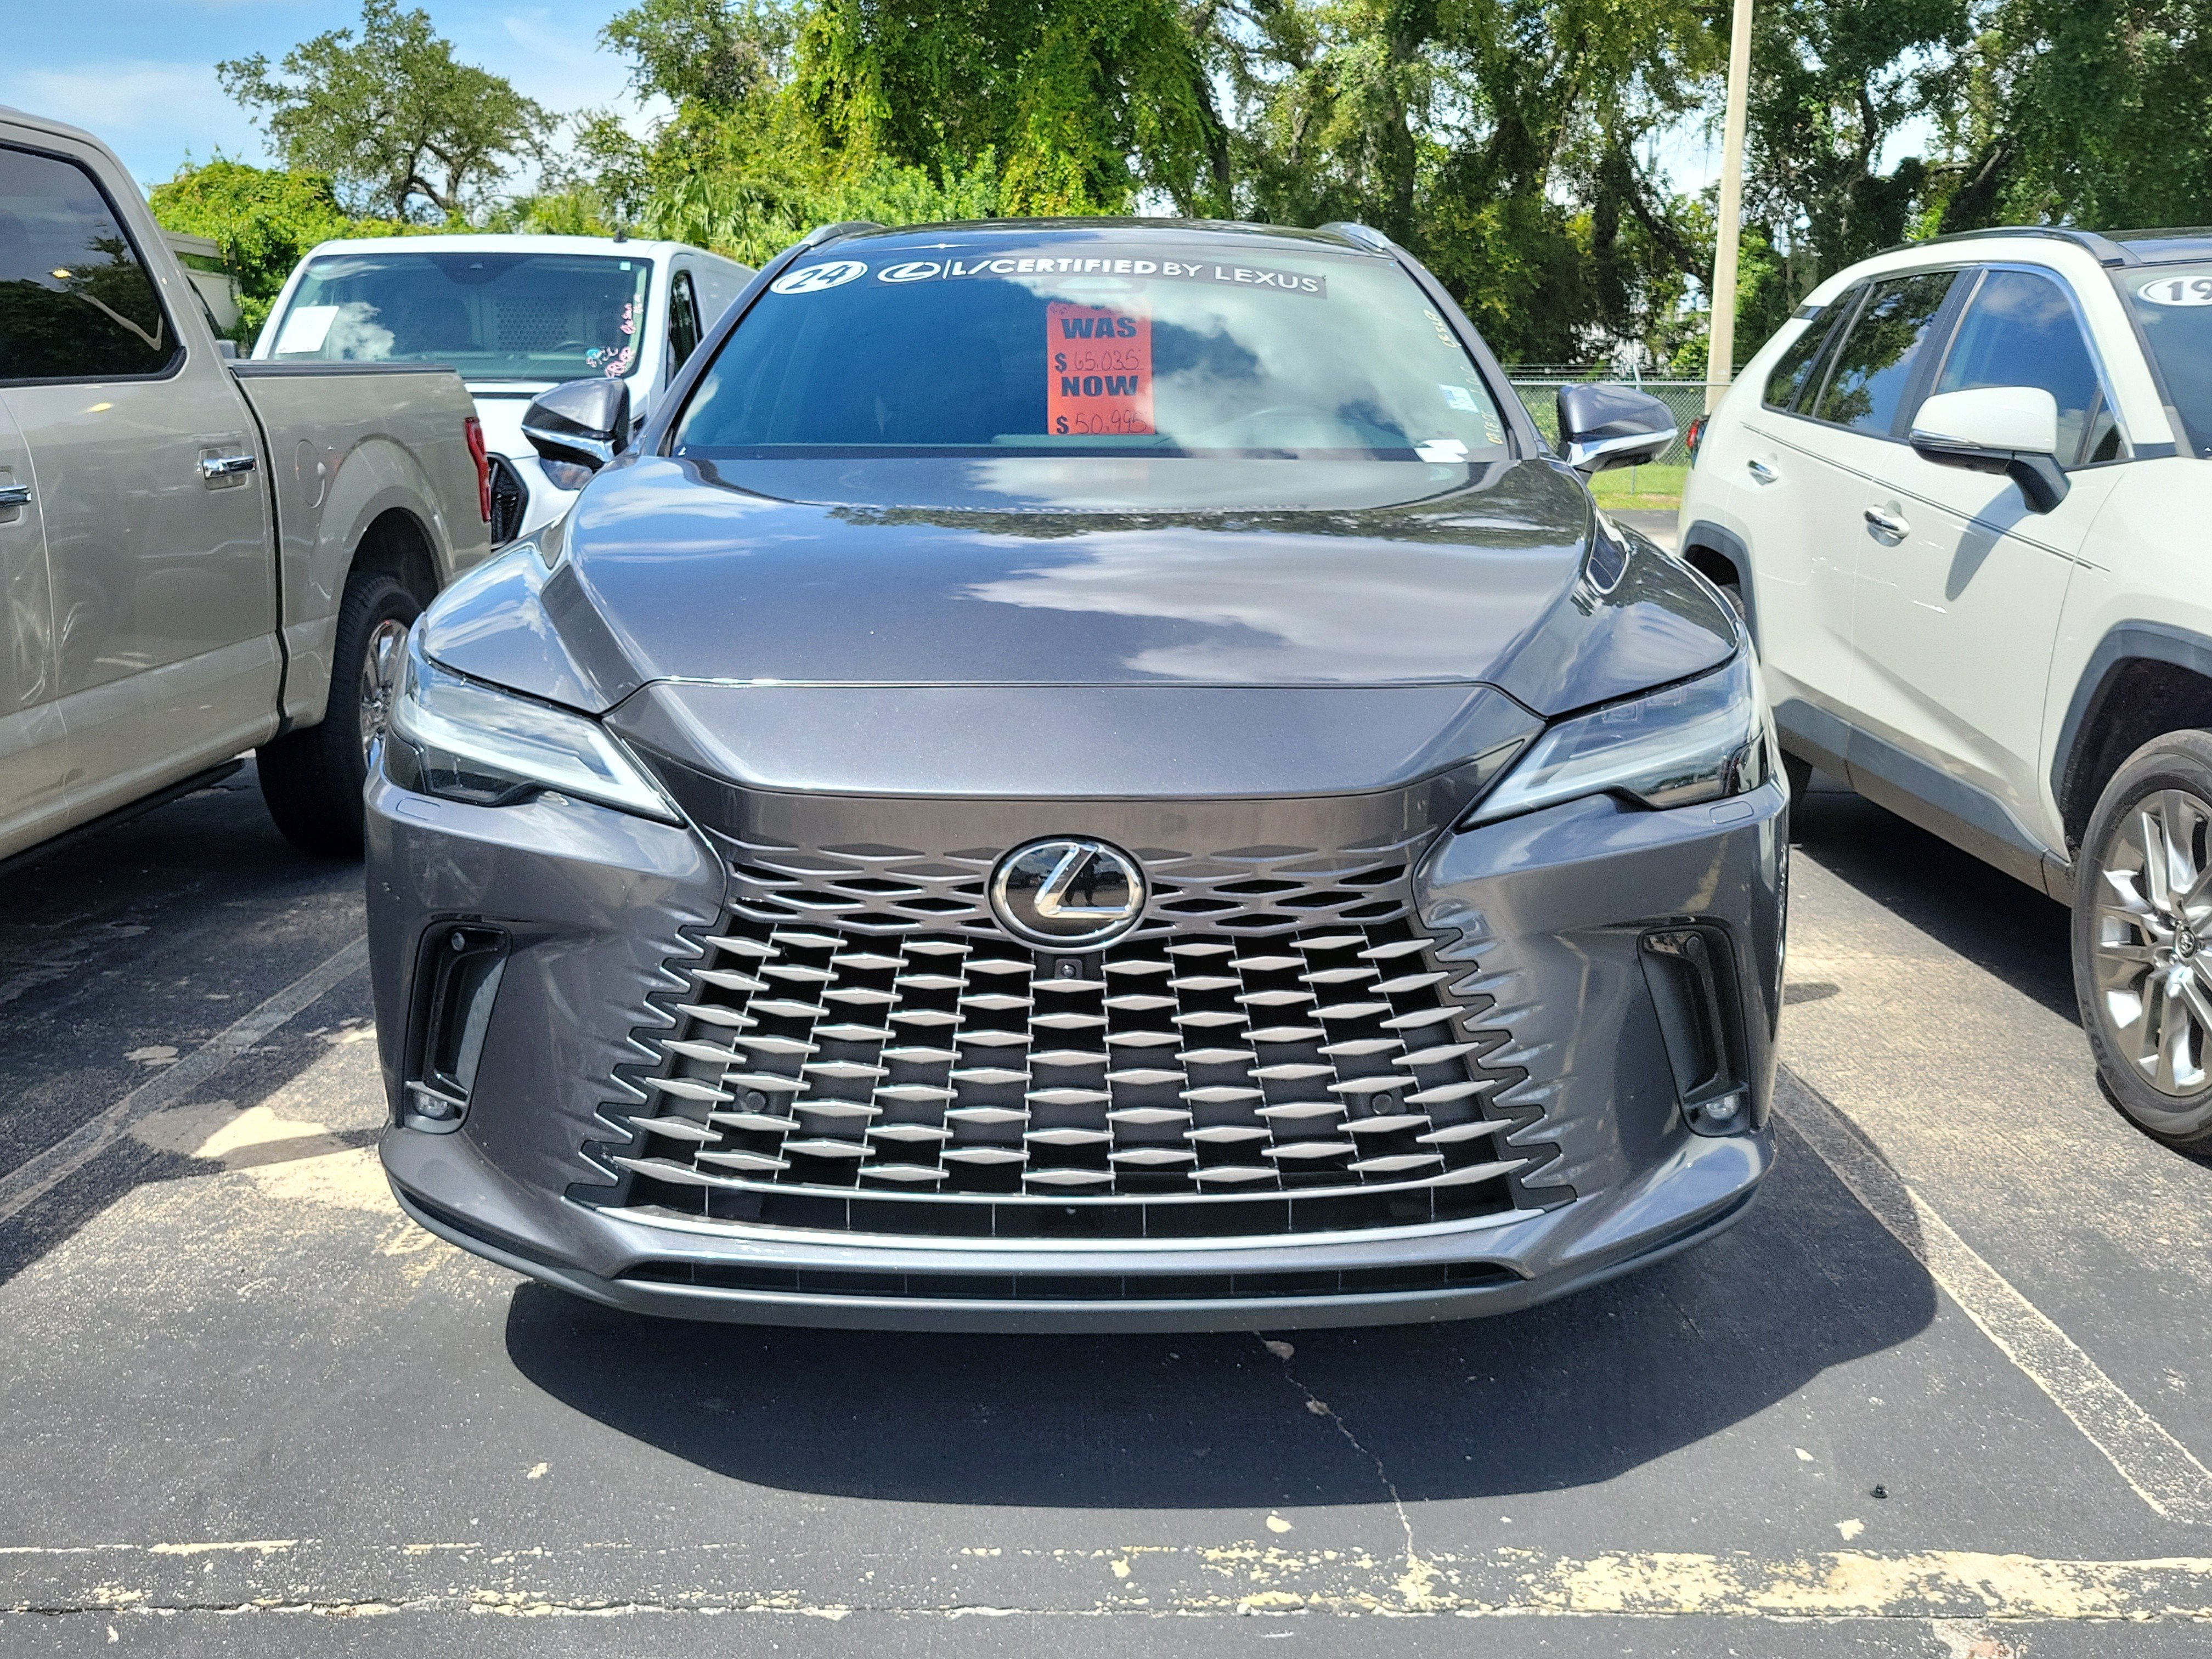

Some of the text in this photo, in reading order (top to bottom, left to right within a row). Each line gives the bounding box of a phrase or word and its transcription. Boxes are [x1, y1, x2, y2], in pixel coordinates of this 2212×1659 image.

[785, 264, 856, 290] 24
[1163, 262, 1203, 278] BY
[1215, 266, 1319, 292] LEXUS
[1060, 317, 1137, 339] WAS
[1054, 352, 1068, 374] $
[1060, 375, 1139, 397] NOW
[1056, 415, 1069, 435] $
